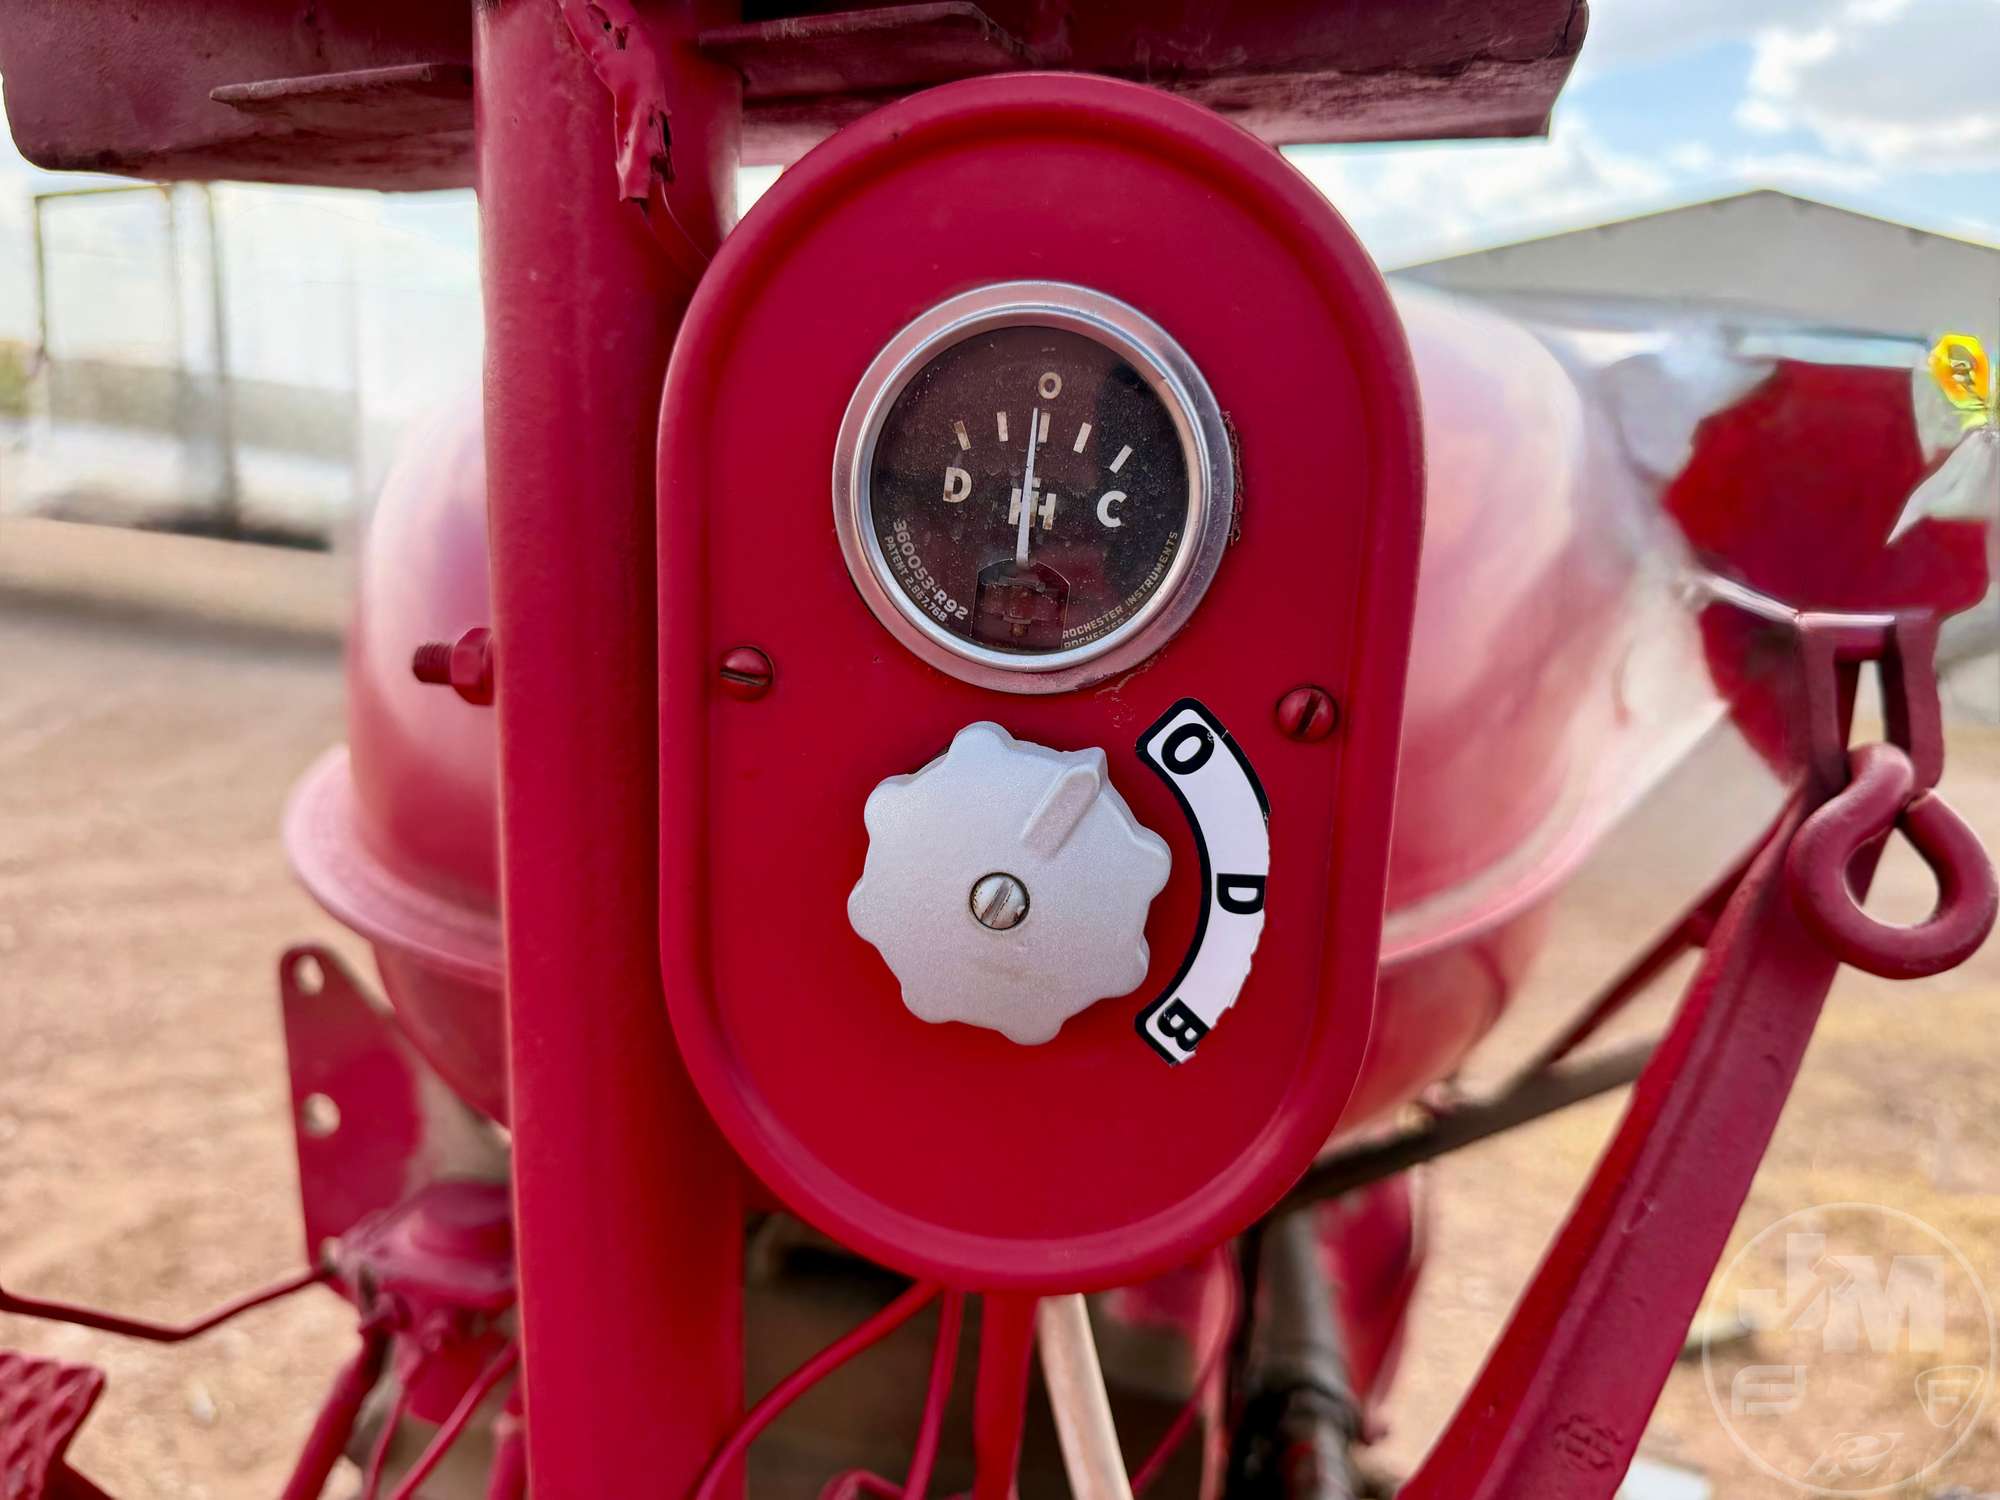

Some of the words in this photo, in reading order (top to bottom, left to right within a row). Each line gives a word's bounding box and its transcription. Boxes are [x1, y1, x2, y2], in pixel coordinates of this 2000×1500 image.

[943, 466, 972, 503] D
[1097, 490, 1127, 528] C
[884, 536, 909, 576] PATENT
[893, 519, 969, 620] 360053-R92
[1062, 604, 1124, 640] ROCHESTER
[1125, 531, 1178, 607] INSTRUMENTS
[1216, 873, 1266, 915] D
[1157, 998, 1211, 1053] B
